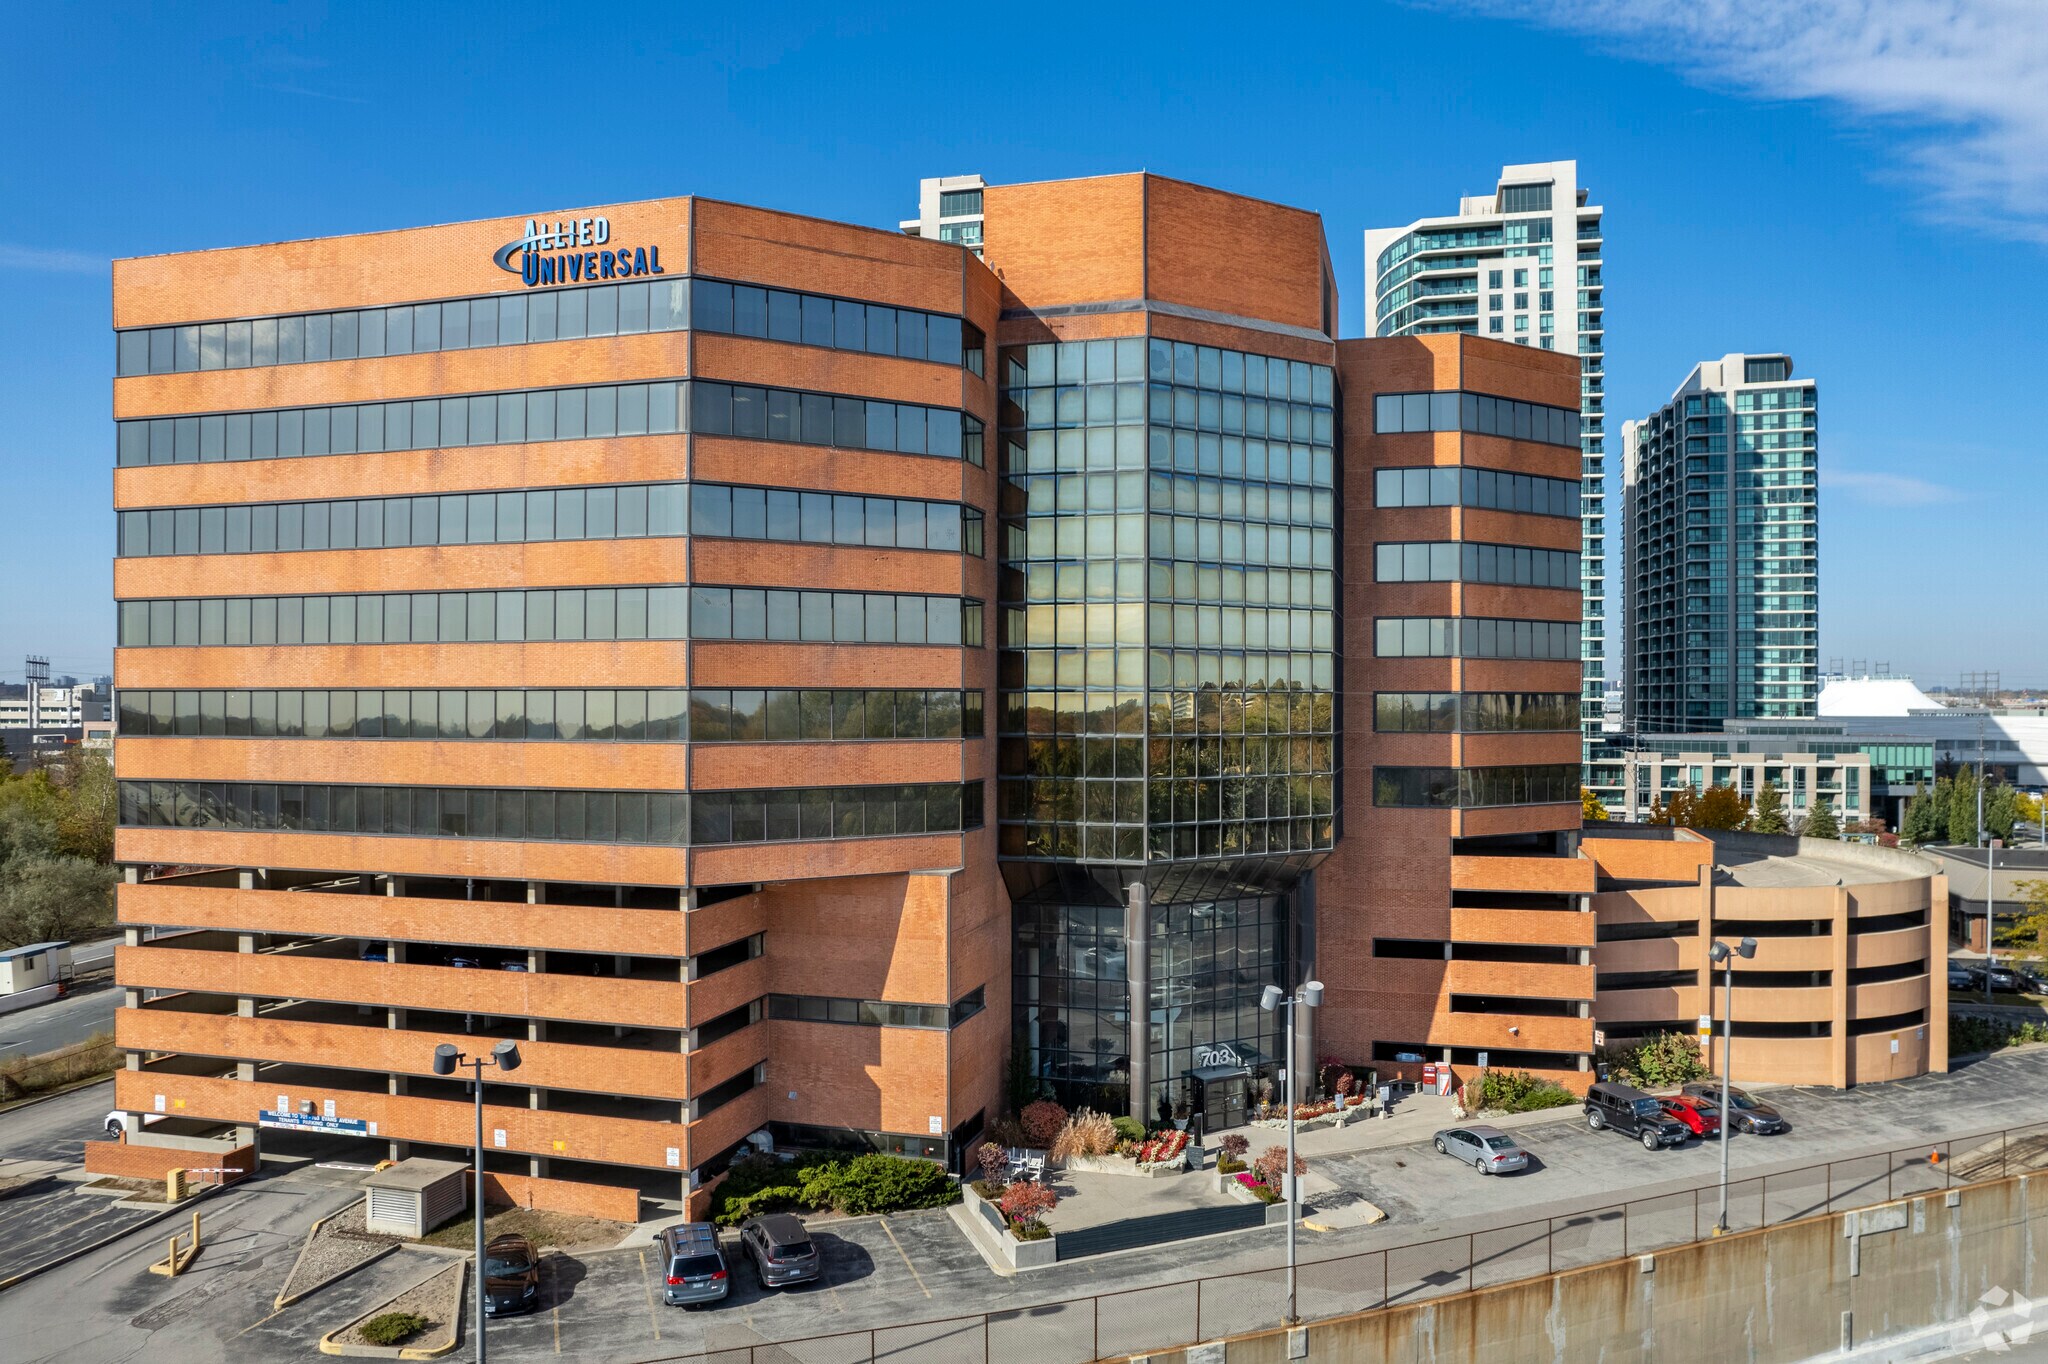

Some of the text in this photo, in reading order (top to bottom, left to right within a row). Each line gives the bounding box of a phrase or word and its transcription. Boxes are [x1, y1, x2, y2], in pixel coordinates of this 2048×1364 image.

[522, 216, 610, 252] ALLIED
[522, 245, 663, 286] UNIVERSAL
[1201, 1049, 1229, 1067] 703
